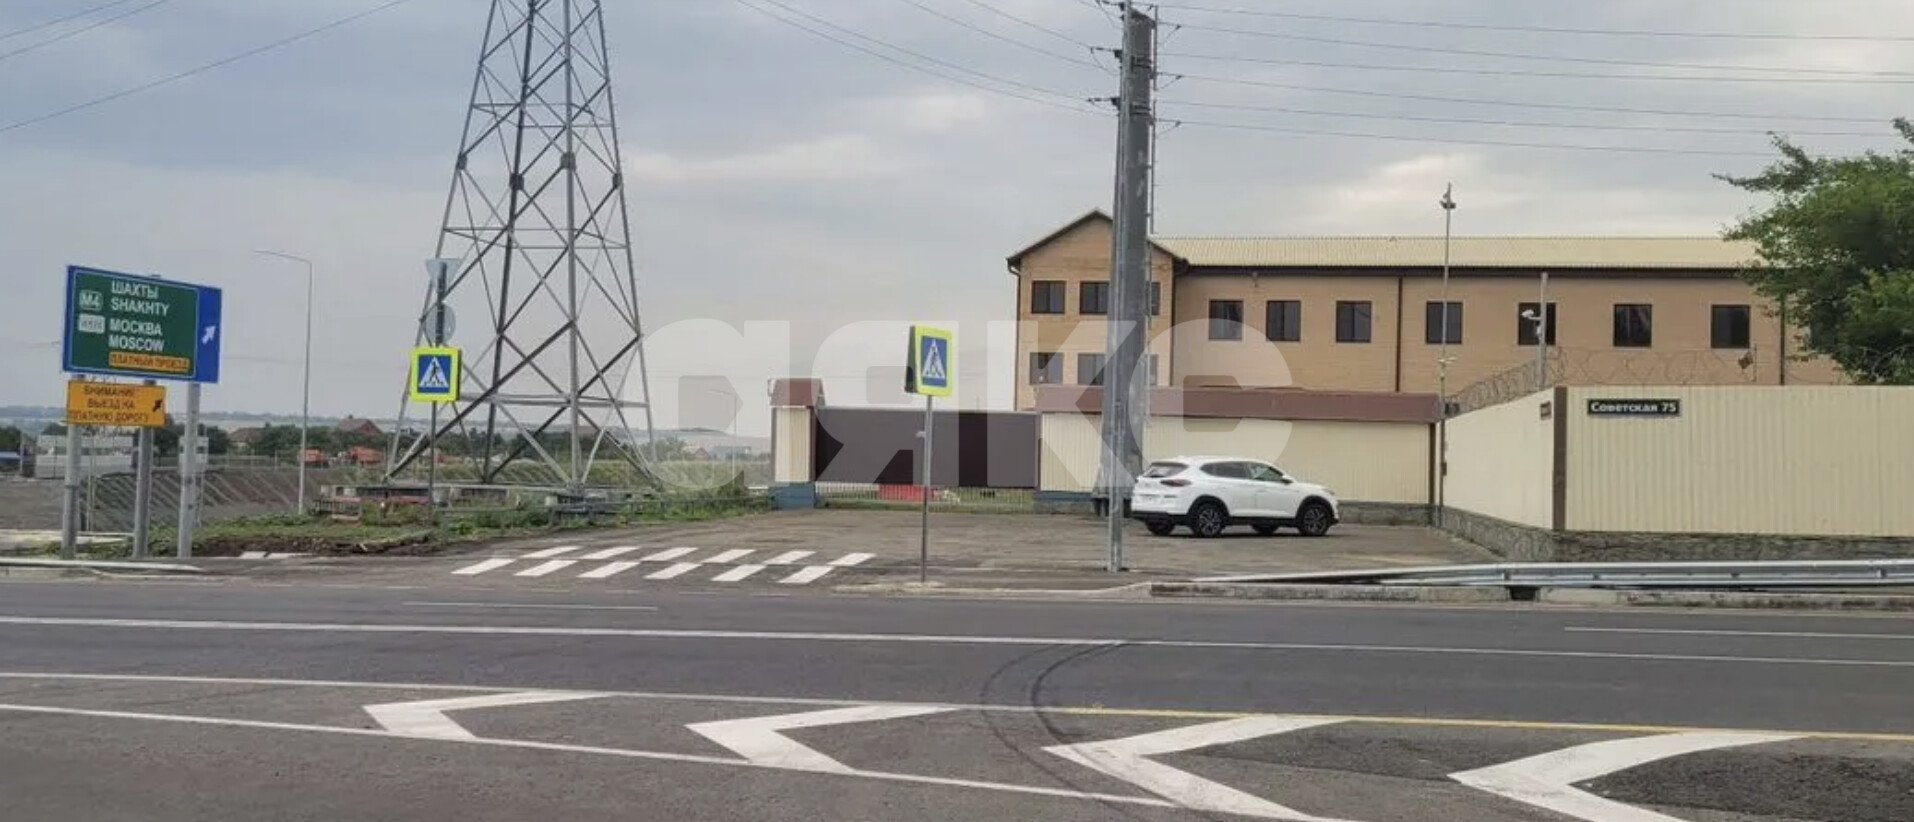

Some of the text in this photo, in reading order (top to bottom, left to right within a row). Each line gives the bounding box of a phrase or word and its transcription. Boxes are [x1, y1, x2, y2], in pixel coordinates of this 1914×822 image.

[111, 280, 159, 299] ШАХТЫ
[110, 299, 170, 317] SHAKHTY
[109, 318, 162, 337] МОСКВА
[109, 335, 165, 353] MOSCOW
[1591, 402, 1677, 412] Советская 75
